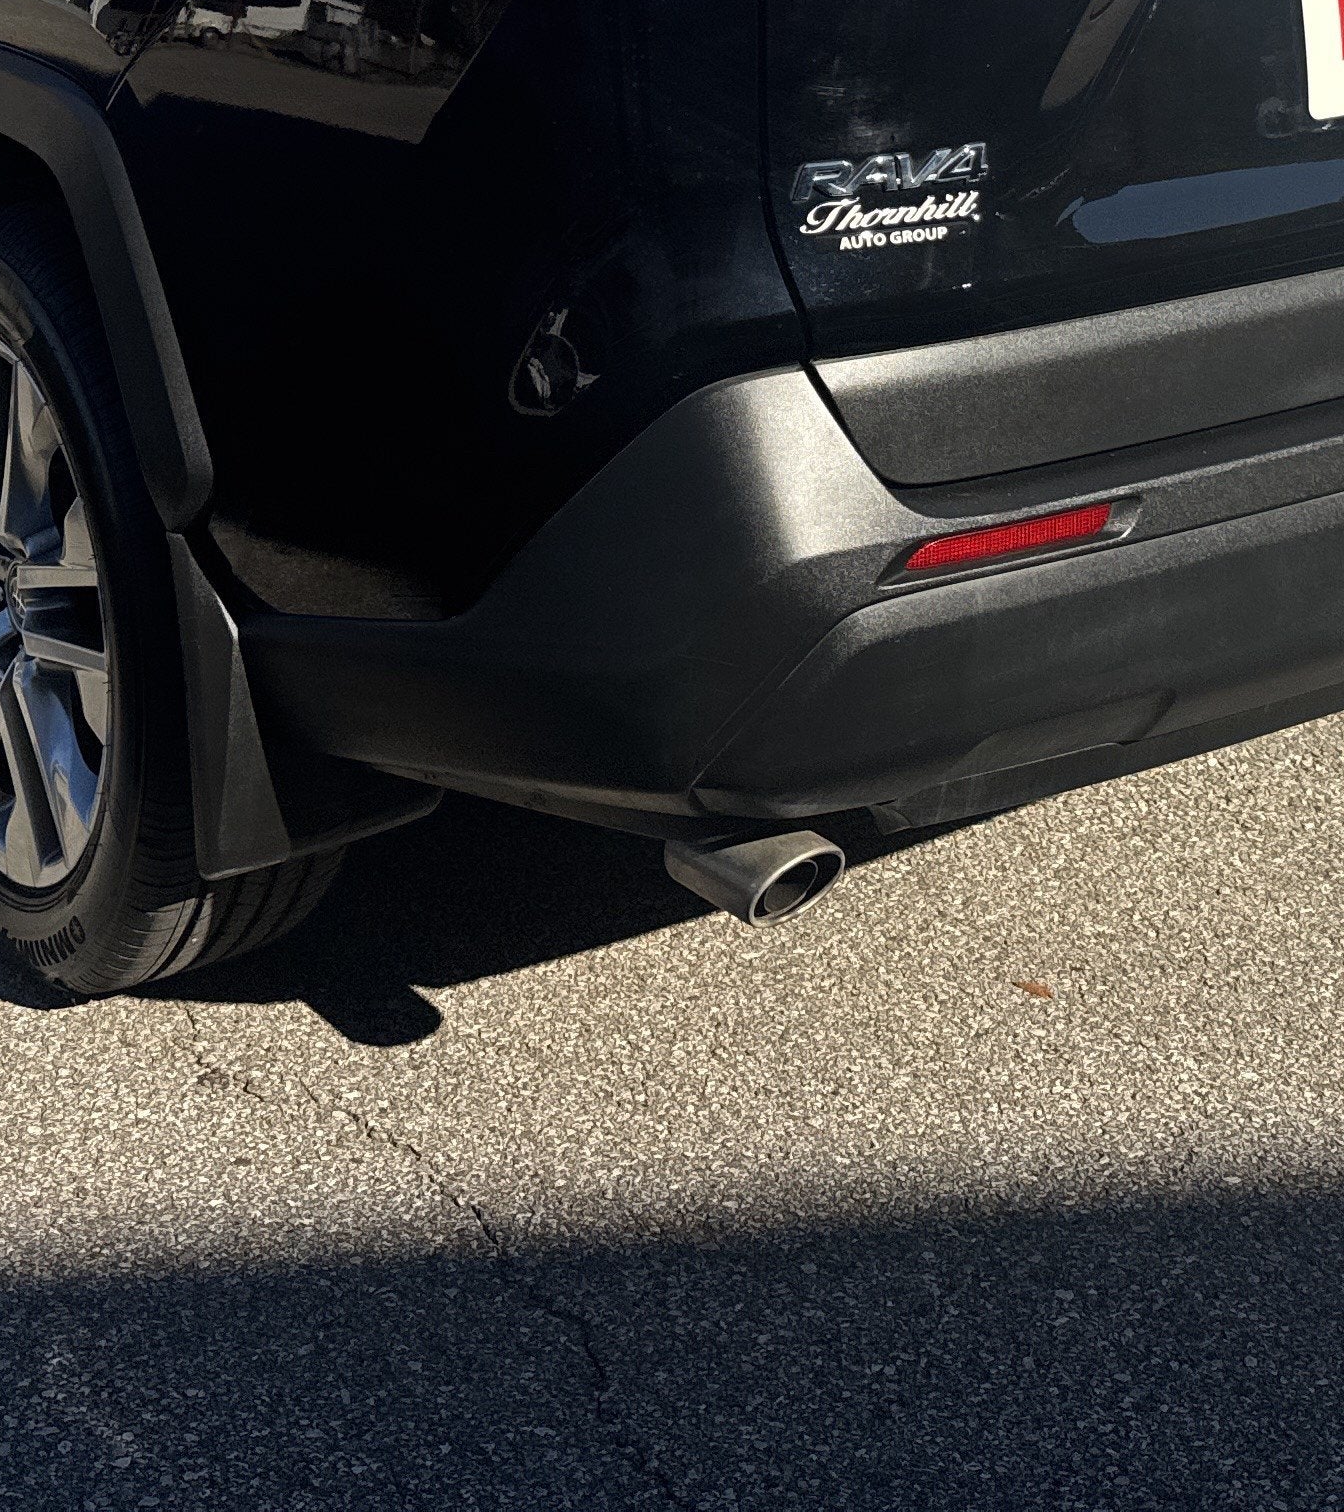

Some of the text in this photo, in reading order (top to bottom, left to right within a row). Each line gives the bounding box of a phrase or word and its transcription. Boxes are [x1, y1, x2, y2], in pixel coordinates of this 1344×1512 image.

[790, 141, 989, 202] RAV4
[799, 189, 980, 235] Thornhill
[839, 225, 948, 251] AUTO GROUP
